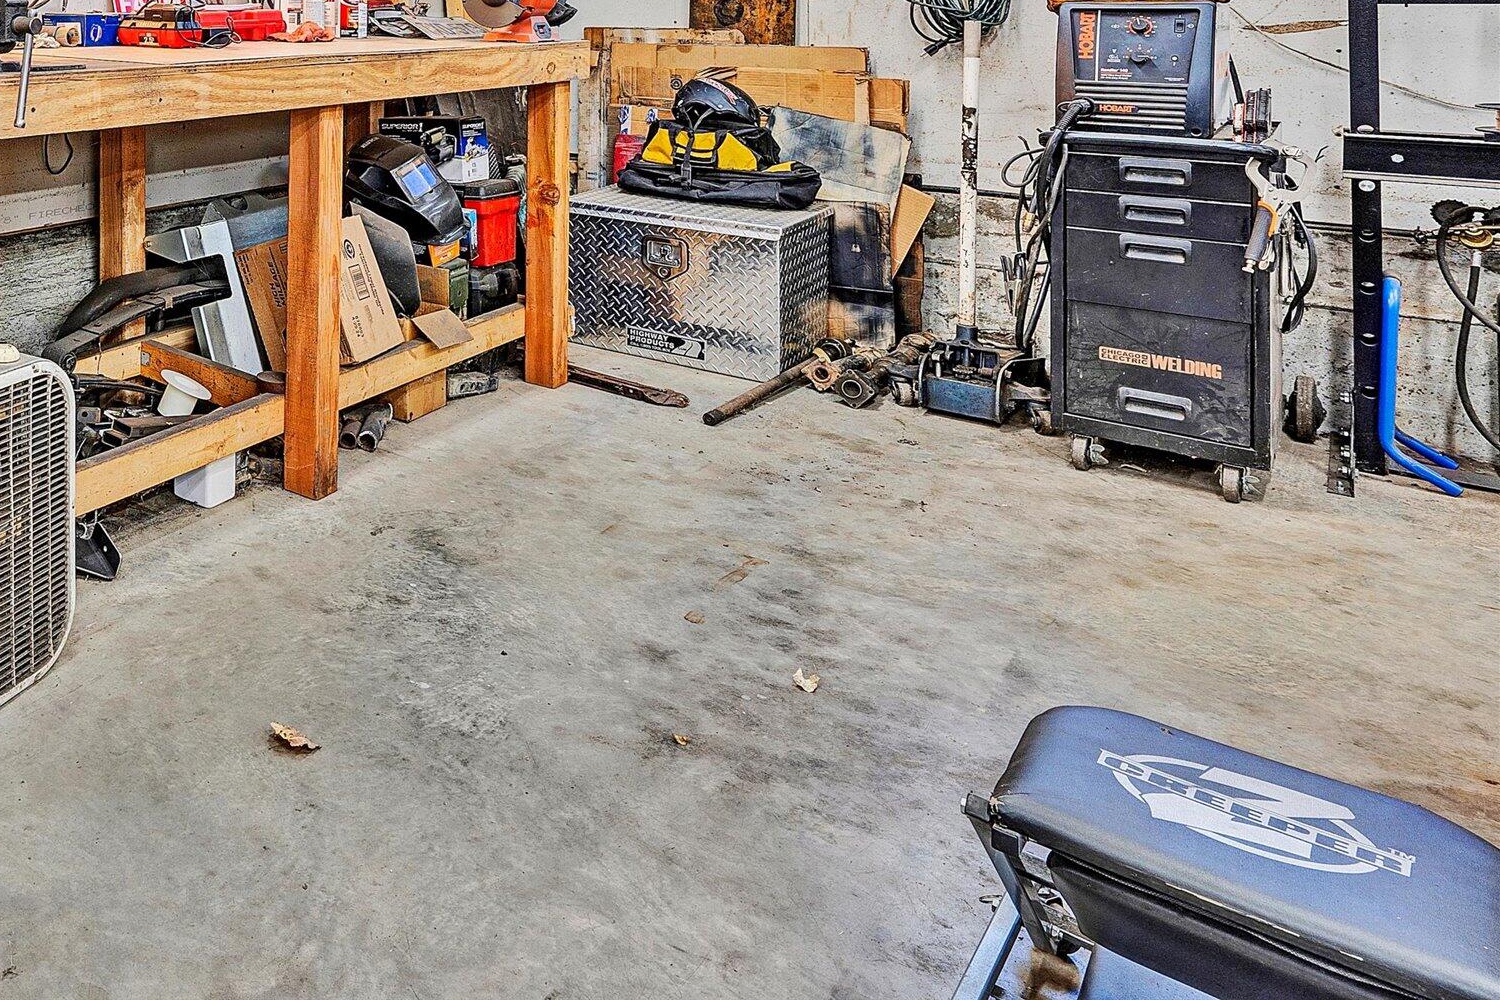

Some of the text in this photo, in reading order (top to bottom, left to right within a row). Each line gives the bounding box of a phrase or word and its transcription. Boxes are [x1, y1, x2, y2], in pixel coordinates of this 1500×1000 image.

[1078, 12, 1096, 60] HOBART
[1099, 104, 1134, 113] HOBART
[629, 329, 669, 342] HIGHWAY
[629, 334, 675, 349] PRODUCTS
[1100, 347, 1140, 359] CHICAGO
[1100, 353, 1223, 380] ELECTRIC WELDING
